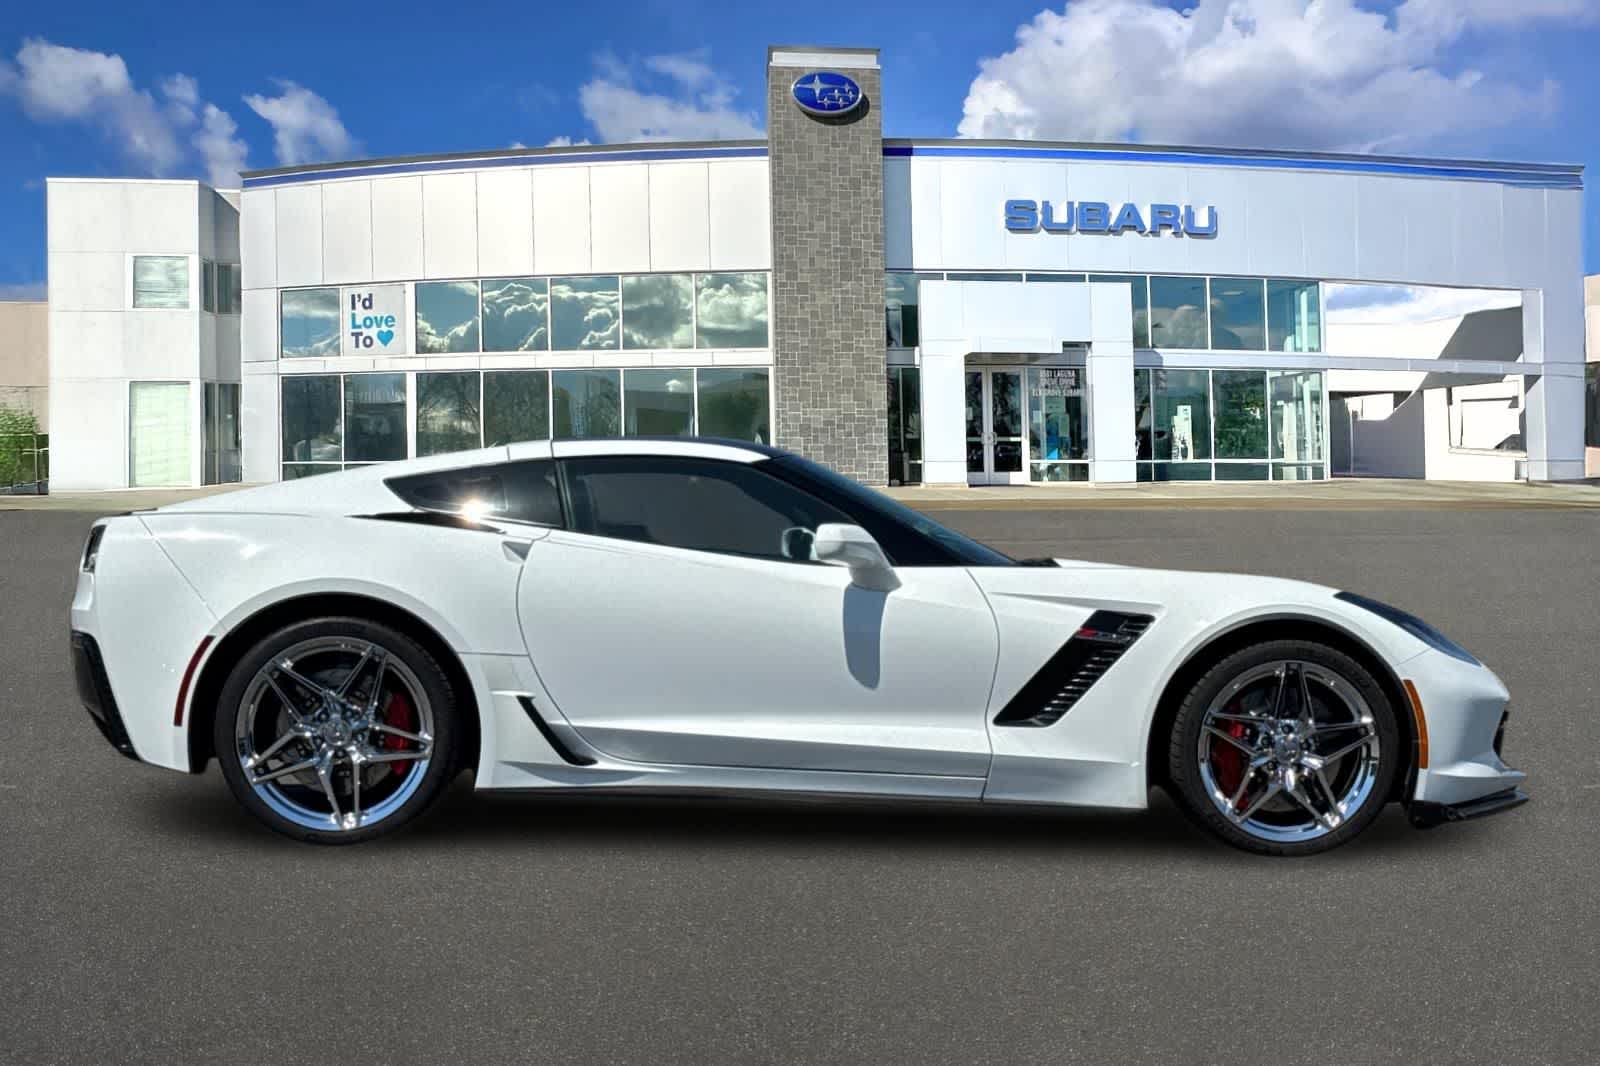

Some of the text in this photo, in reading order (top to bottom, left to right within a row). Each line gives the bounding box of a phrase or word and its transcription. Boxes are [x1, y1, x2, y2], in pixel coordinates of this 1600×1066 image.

[1005, 199, 1216, 237] SUBARU
[351, 293, 373, 310] I'd
[351, 312, 396, 329] Love
[351, 331, 373, 348] To
